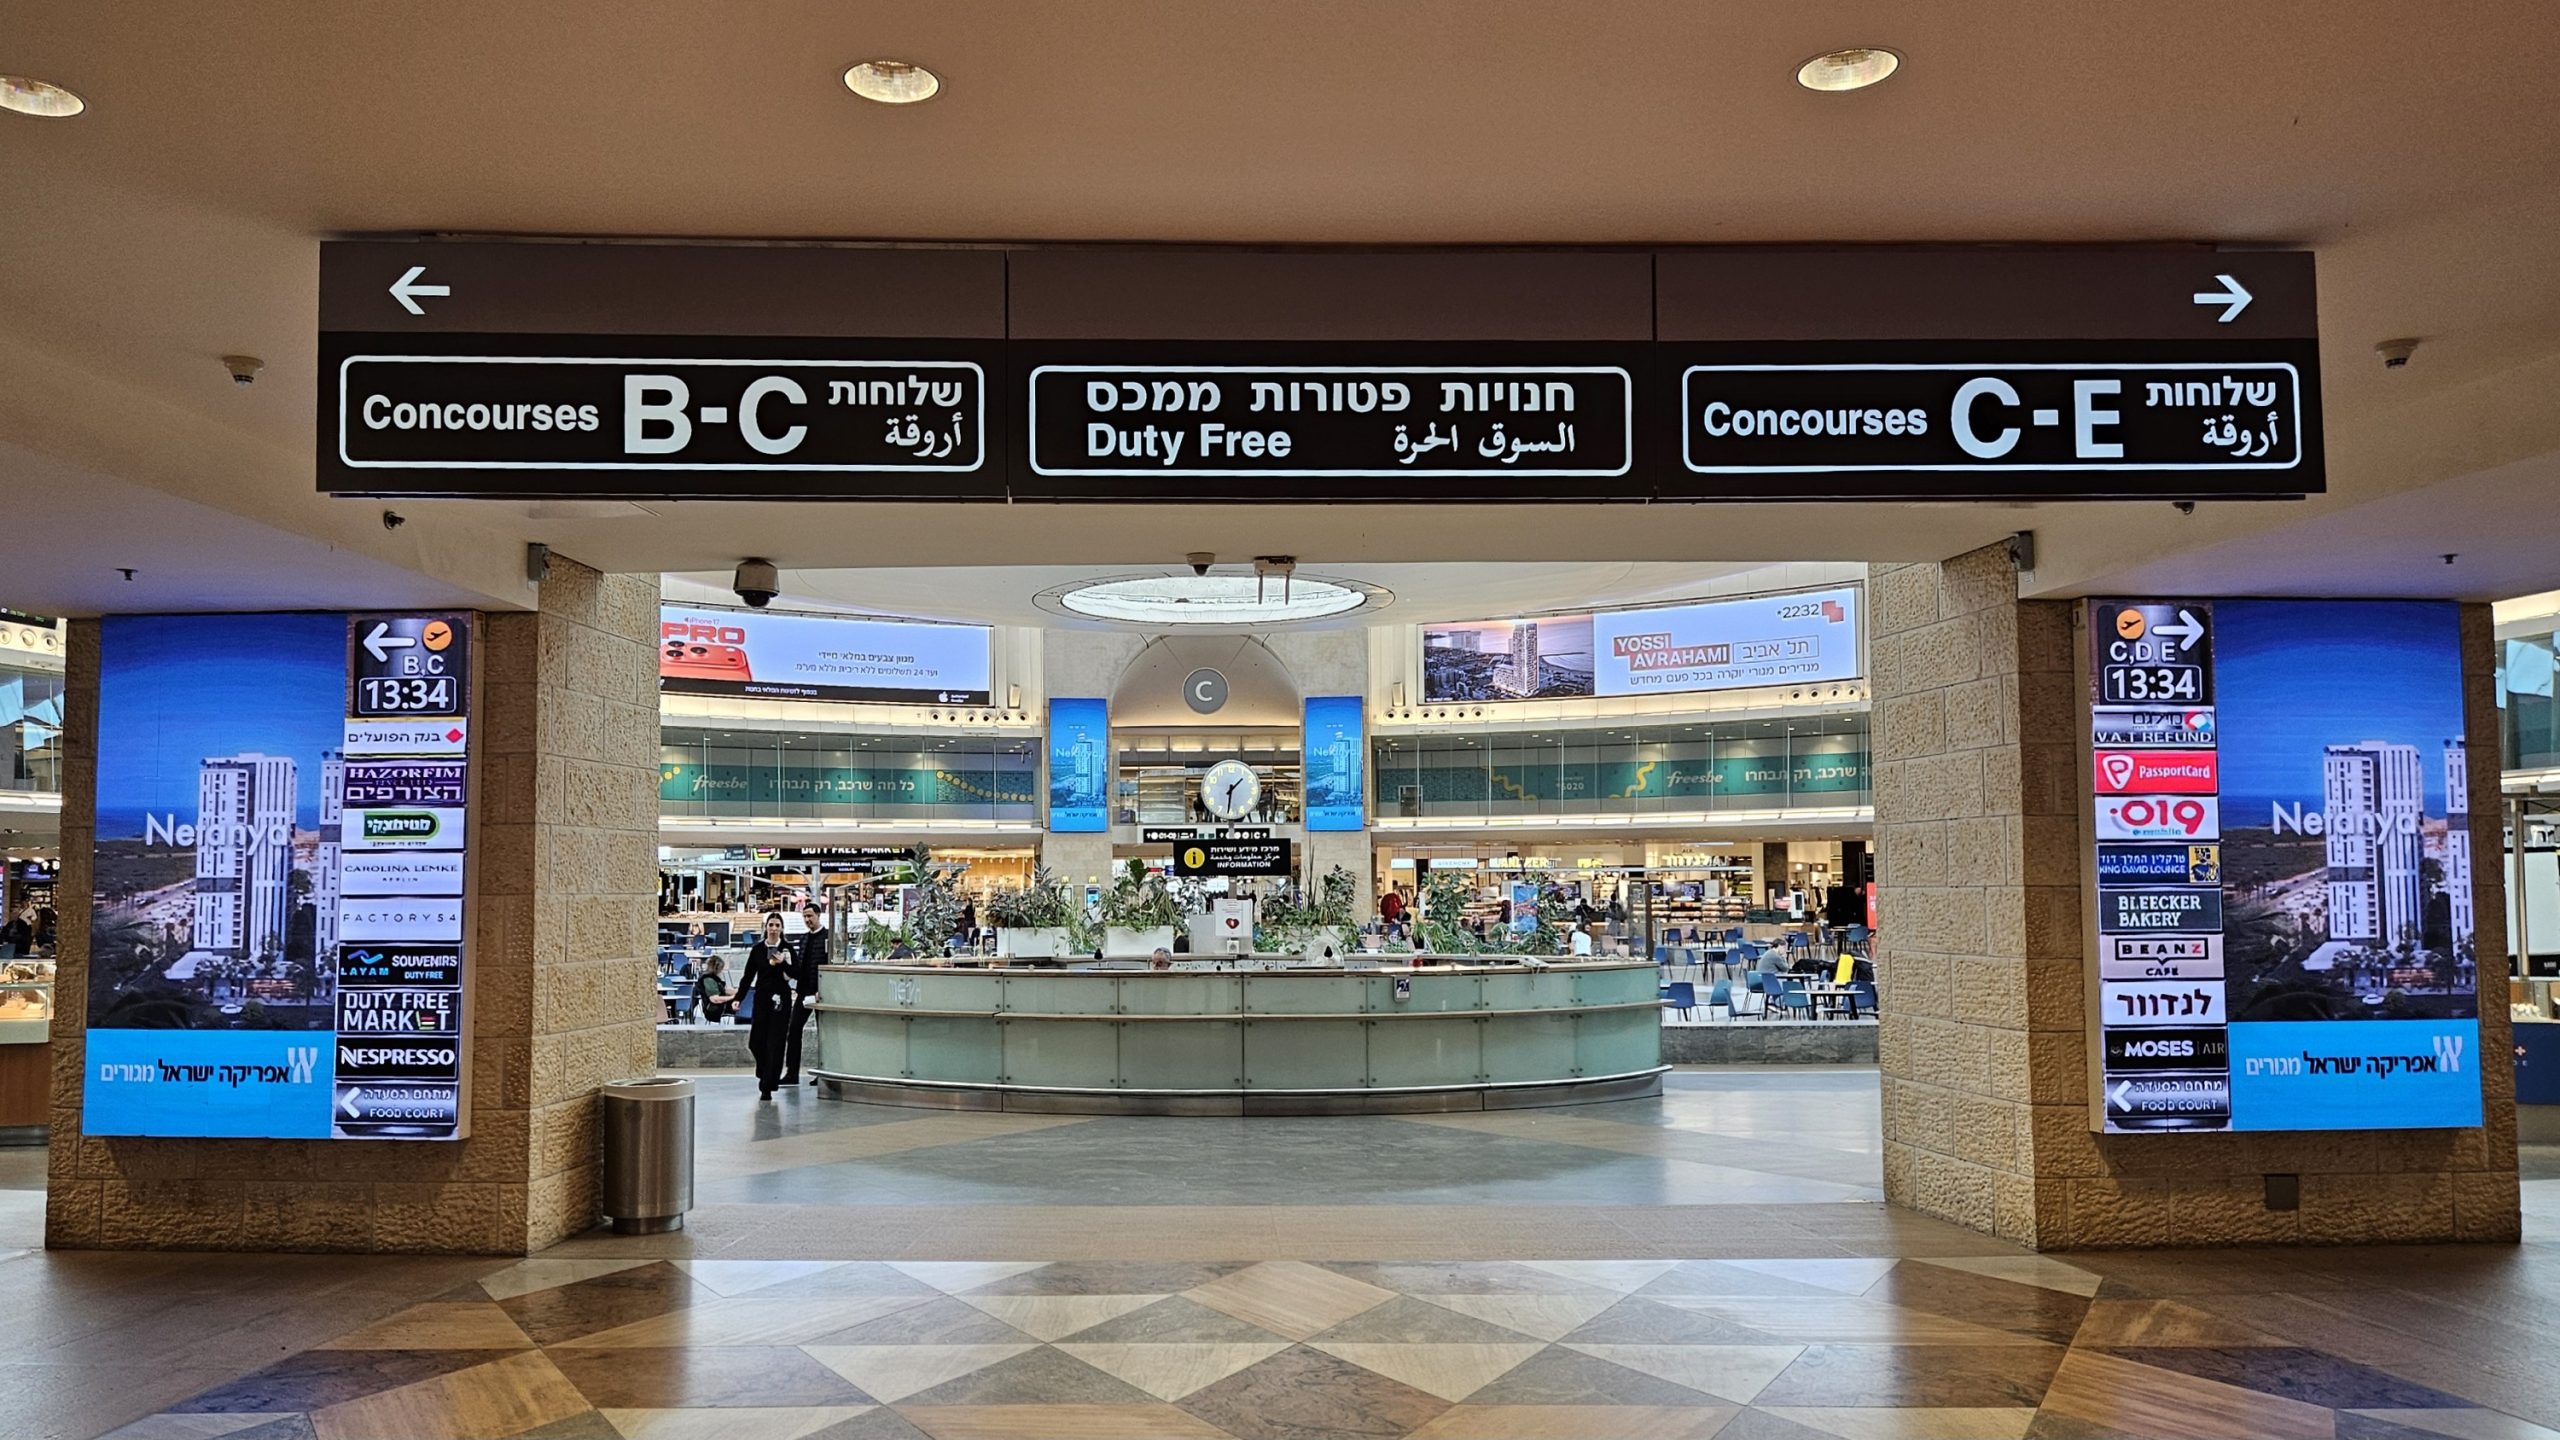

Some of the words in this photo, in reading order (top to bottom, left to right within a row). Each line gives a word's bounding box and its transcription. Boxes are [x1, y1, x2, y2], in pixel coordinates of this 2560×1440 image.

[828, 374, 963, 407] שלוחות
[1087, 381, 1222, 413] ממכס
[1250, 381, 1411, 414] פטורות
[1441, 381, 1575, 412] חנויות
[2145, 375, 2277, 407] שלוחות
[363, 393, 599, 432] Concourses
[624, 374, 808, 455] B-C
[1703, 401, 1928, 437] Concourses
[1950, 376, 2125, 459] C-E
[884, 411, 963, 458] أروقة
[2202, 410, 2279, 456] أروقة
[1087, 423, 1185, 466] Duty
[1200, 424, 1293, 458] Free
[1393, 422, 1458, 464] الحرة
[1478, 422, 1575, 463] السوق
[689, 617, 712, 625] iPhone
[661, 621, 745, 645] PRO
[1615, 635, 1670, 653] YOSSI
[1742, 642, 1781, 659] אביב
[1786, 639, 1810, 655] תל
[841, 652, 867, 662] במלאי
[868, 654, 894, 663] צבעים
[1633, 646, 1728, 668] AVRAHAMI
[860, 665, 876, 675] ללא
[1692, 669, 1713, 681] בכל
[1717, 668, 1745, 681] יוקרה
[1778, 662, 1820, 676] מגדירים
[1629, 674, 1662, 685] מחדש
[1666, 672, 1689, 682] פעם
[2112, 668, 2196, 699] 13:34
[365, 679, 449, 710] 13:34
[1195, 680, 1213, 702] C
[347, 731, 410, 744] הפועלים
[414, 733, 442, 744] בנק
[2142, 731, 2212, 743] REFUND
[349, 767, 462, 779] HAZORFIM
[1666, 771, 1724, 788] freesbe
[1792, 768, 1812, 783] רק
[1815, 767, 1857, 781] שרכב,
[2139, 765, 2211, 779] PassportCard
[692, 775, 748, 792] freesbe
[814, 780, 832, 793] רק
[834, 780, 873, 792] שרכב,
[877, 780, 896, 791] מה
[900, 780, 915, 791] כל
[346, 786, 461, 800] הצורפים
[2121, 800, 2205, 835] 019
[2272, 800, 2417, 845] Netanya
[145, 812, 288, 856] Netanya
[1216, 861, 1271, 869] INFORMATION
[2100, 854, 2117, 864] דוד
[2120, 854, 2148, 864] המלך
[2151, 854, 2186, 864] טרקלין
[344, 864, 411, 874] CAROLINA
[413, 864, 458, 873] LEMKE
[2099, 865, 2120, 873] KING
[2121, 865, 2149, 874] DAVID
[2150, 865, 2186, 874] LOUNGE
[2117, 896, 2202, 911] BLEECKER
[343, 914, 431, 923] FACTORY
[437, 914, 457, 922] 54
[2118, 912, 2182, 927] BAKERY
[2121, 943, 2203, 955] BEANZ
[391, 954, 458, 968] SOUVENIRS
[340, 967, 389, 977] LAYAM
[404, 971, 424, 980] DUTY
[425, 971, 444, 980] FREE
[345, 992, 396, 1009] DUTY
[401, 992, 450, 1009] FREE
[2116, 988, 2212, 1017] לנדוור
[343, 1009, 450, 1032] MARKET
[2123, 1040, 2194, 1057] MOSES
[2202, 1043, 2225, 1054] AIR
[339, 1045, 456, 1068] NESPRESSO
[2302, 1050, 2361, 1075] ישראל
[100, 1063, 155, 1082] מגורים
[157, 1058, 214, 1083] ישראל
[2244, 1055, 2301, 1076] מגורים
[2365, 1054, 2437, 1079] אפריקה
[219, 1064, 291, 1088] אפריקה
[2134, 1081, 2180, 1093] הסעדה
[2184, 1080, 2224, 1092] מתחם
[364, 1088, 409, 1100] הסעדה
[413, 1088, 451, 1100] מתחם
[369, 1107, 402, 1118] FOOD
[405, 1107, 445, 1118] COURT
[2141, 1101, 2176, 1112] FOOD
[2178, 1099, 2218, 1111] COURT
